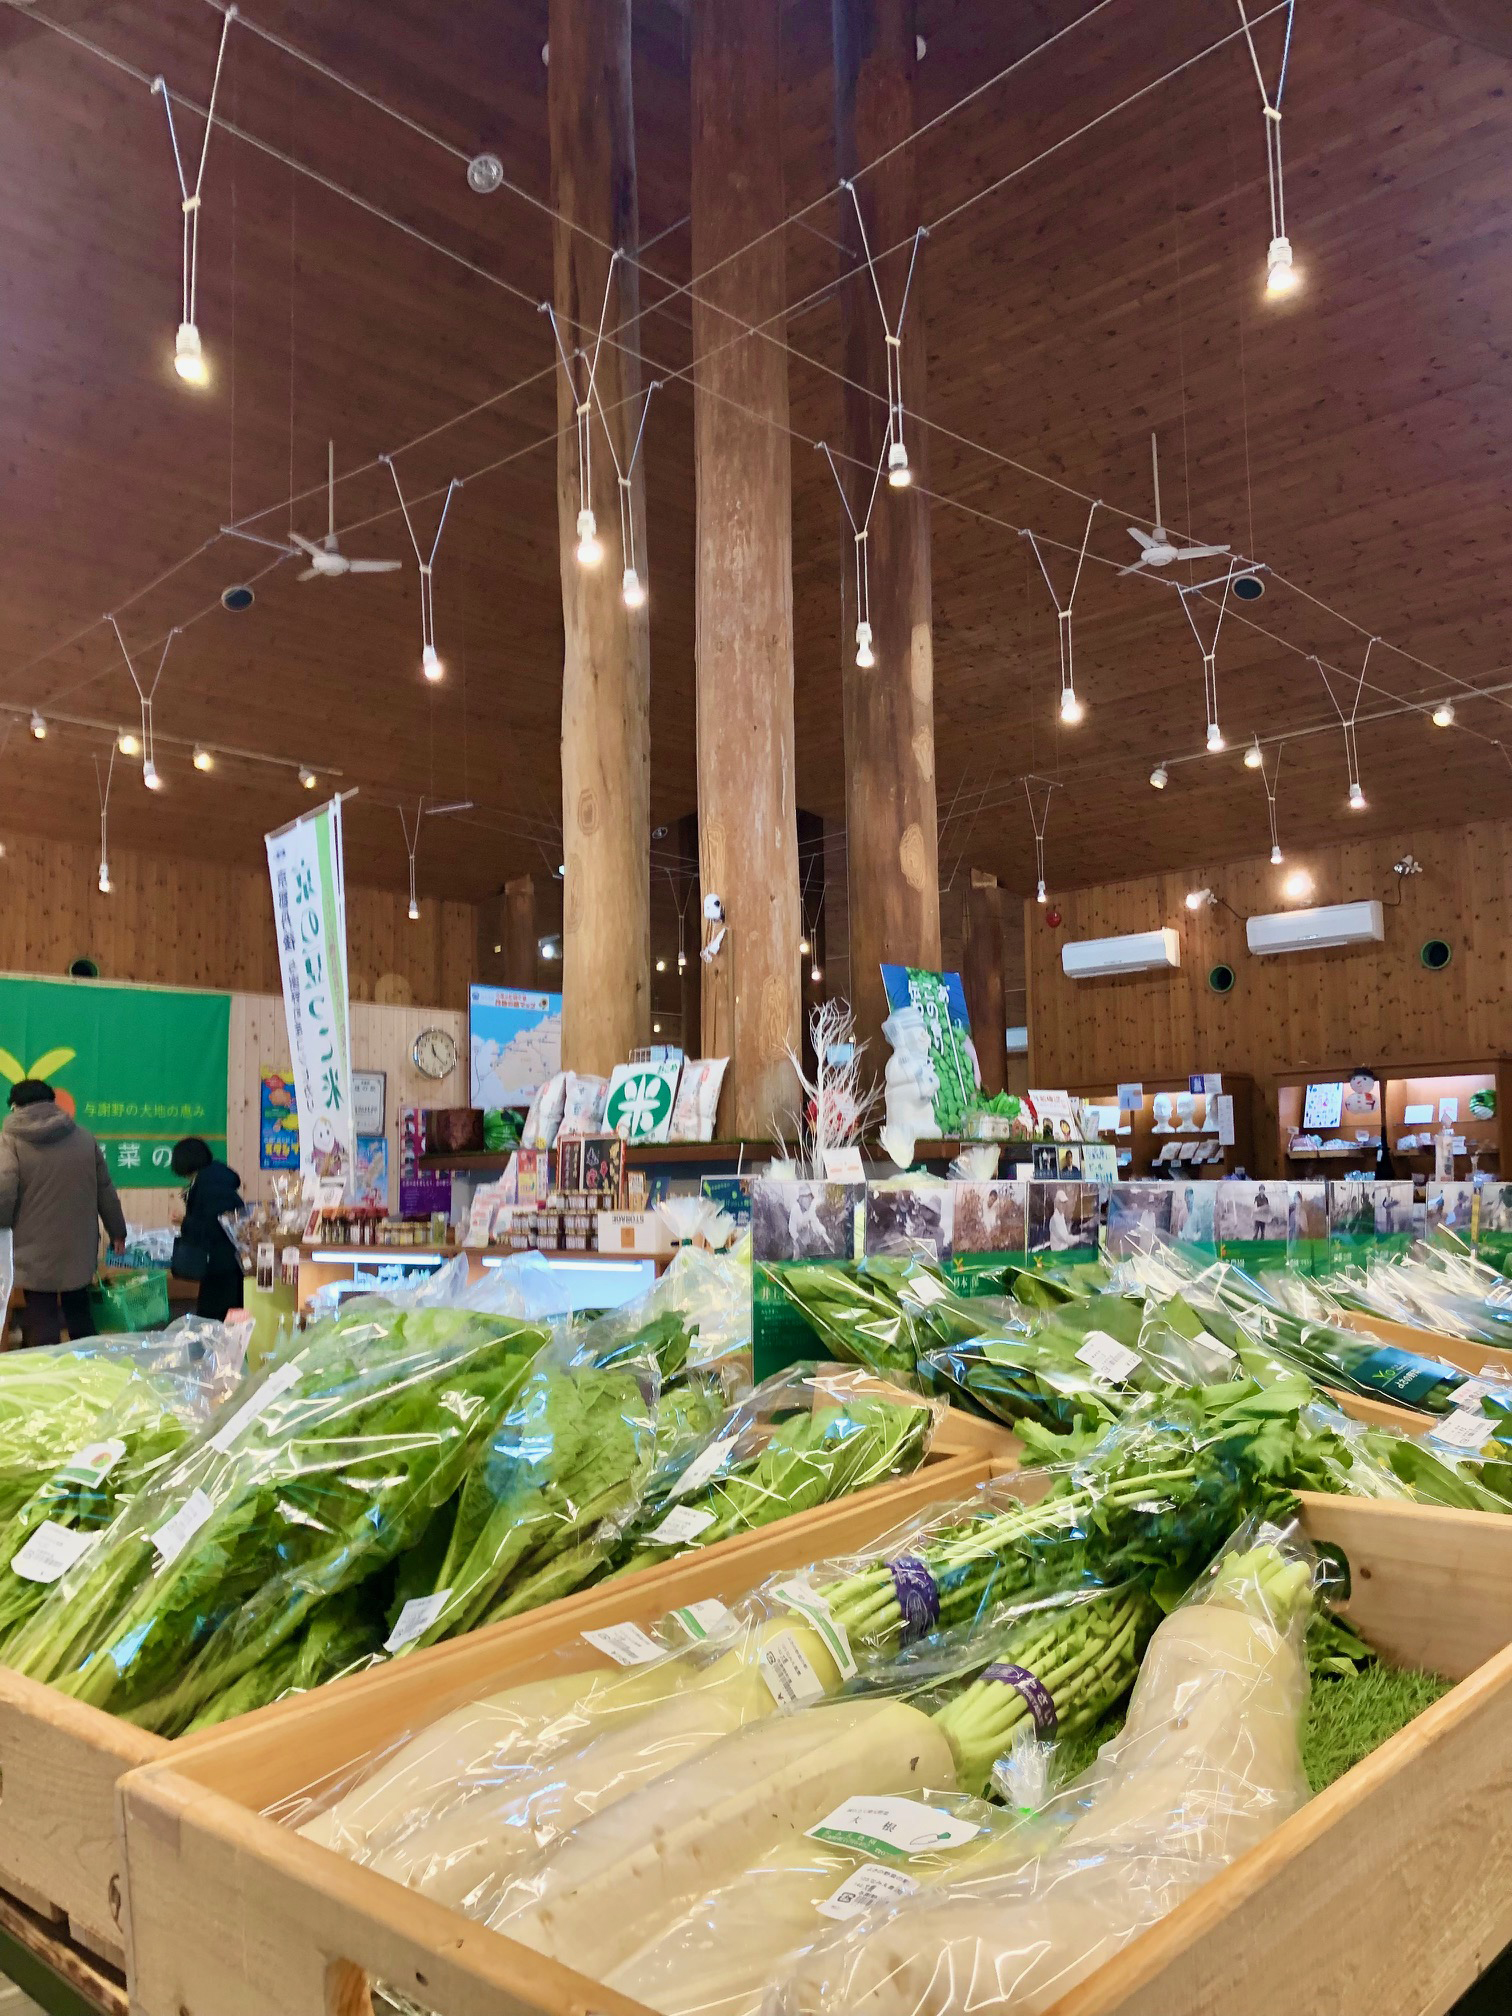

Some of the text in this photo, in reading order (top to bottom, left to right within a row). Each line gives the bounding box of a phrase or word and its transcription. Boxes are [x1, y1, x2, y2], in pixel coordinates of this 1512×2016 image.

[84, 1103, 205, 1118] 与謝野の大地の恵み
